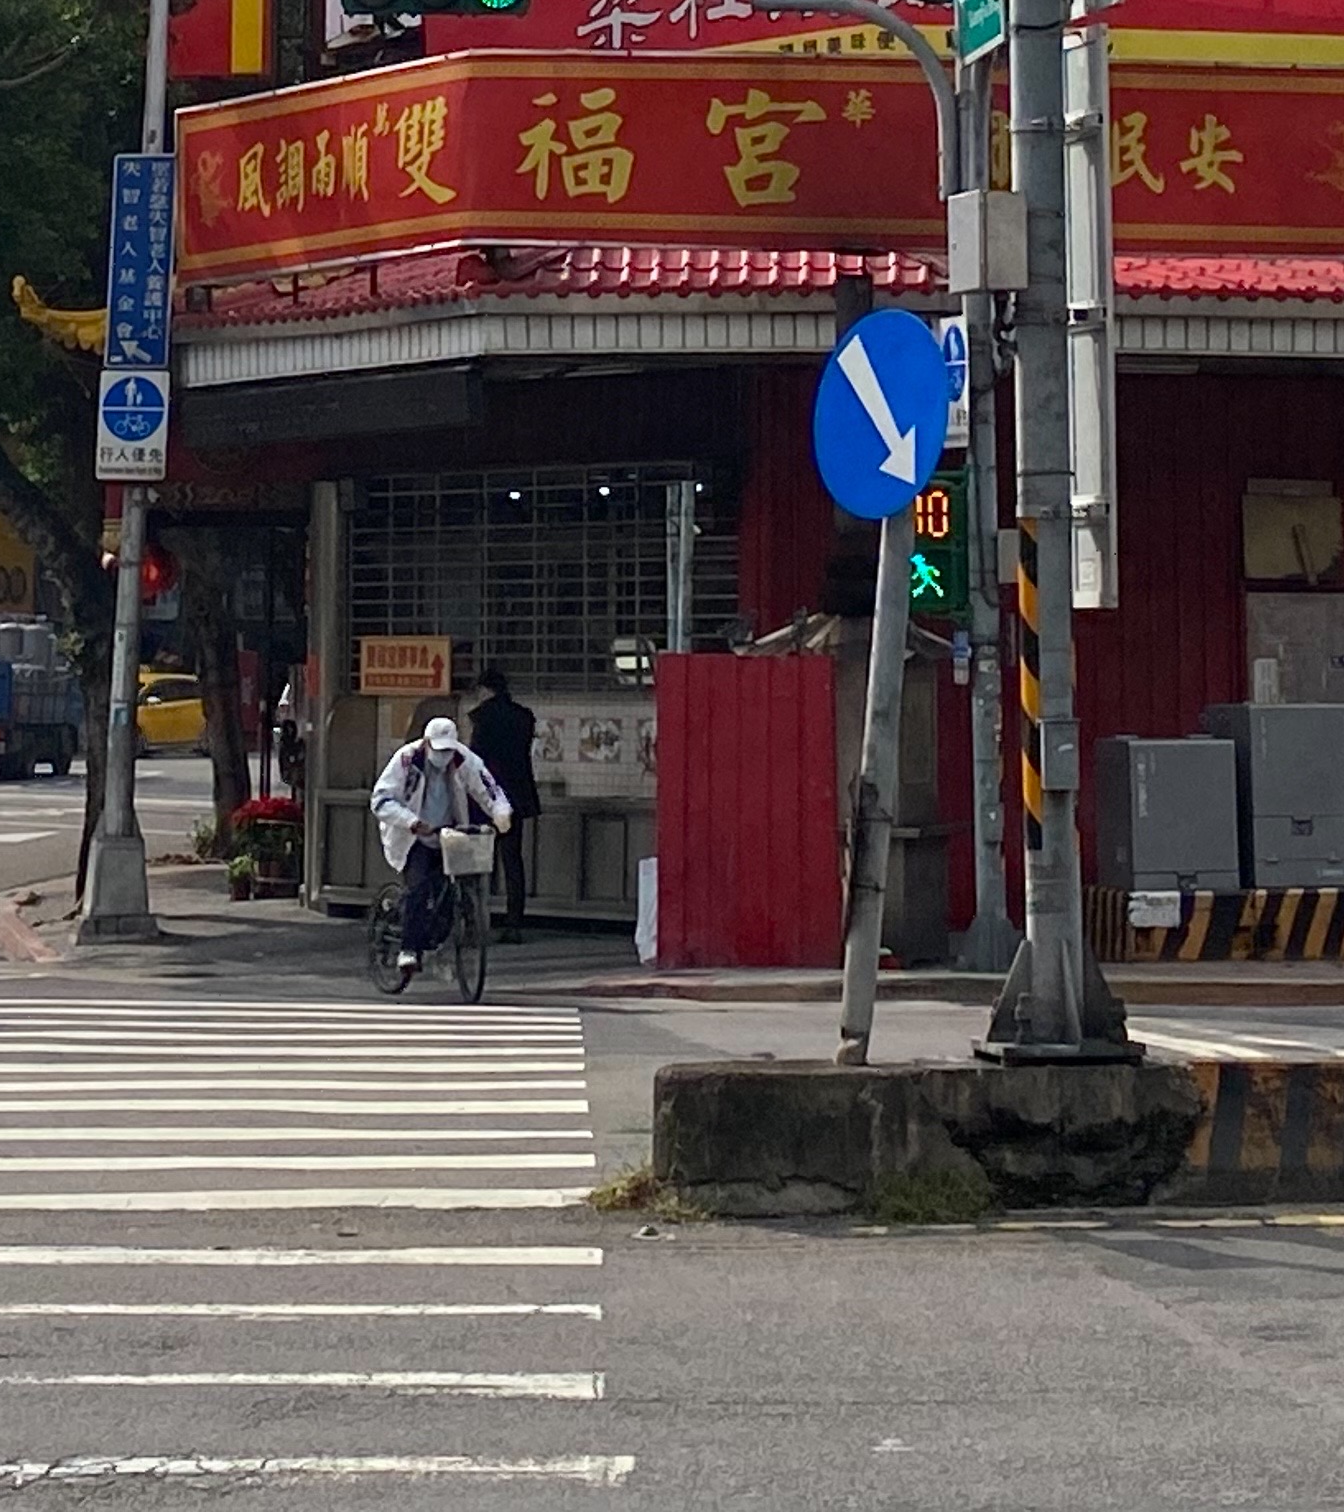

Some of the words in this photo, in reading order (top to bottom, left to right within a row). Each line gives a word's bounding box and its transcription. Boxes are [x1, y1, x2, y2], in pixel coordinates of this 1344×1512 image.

[237, 123, 370, 218] 風調雨順
[394, 88, 829, 208] 雙福宮
[116, 161, 141, 339] 失智老人基金會
